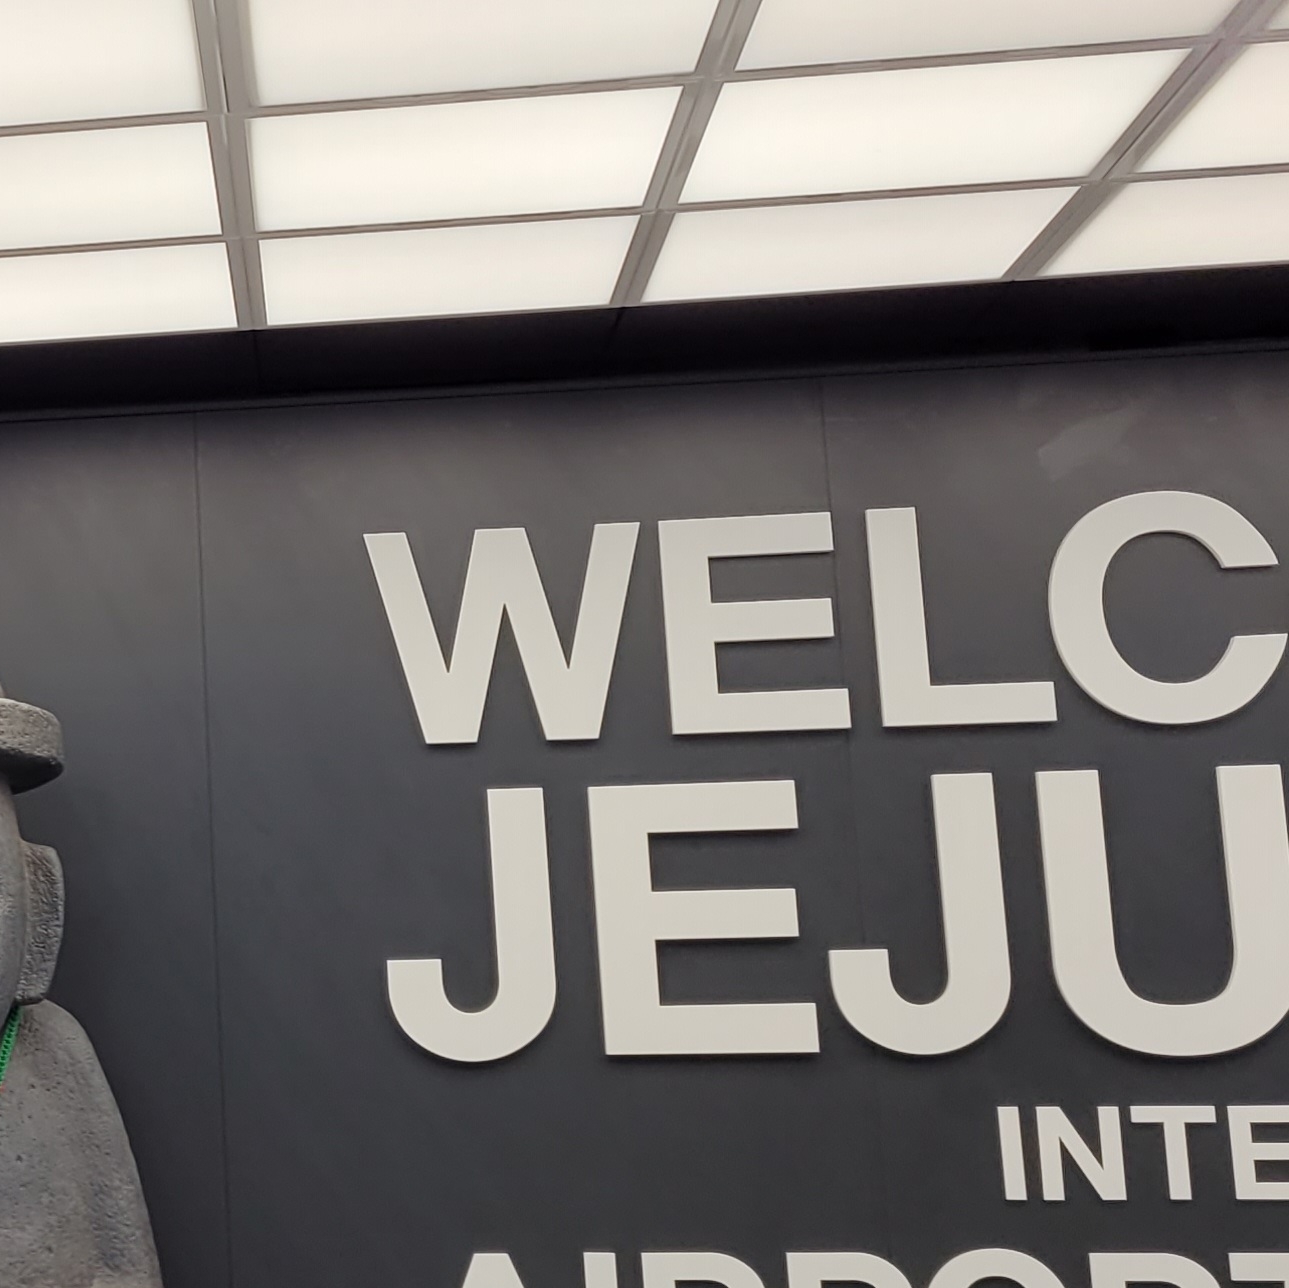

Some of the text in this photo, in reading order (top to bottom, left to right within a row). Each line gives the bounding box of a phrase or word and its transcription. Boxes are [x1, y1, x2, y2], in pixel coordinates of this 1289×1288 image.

[363, 490, 1289, 745] WELC
[387, 764, 1289, 1063] JEJU
[998, 1105, 1289, 1200] INTE
